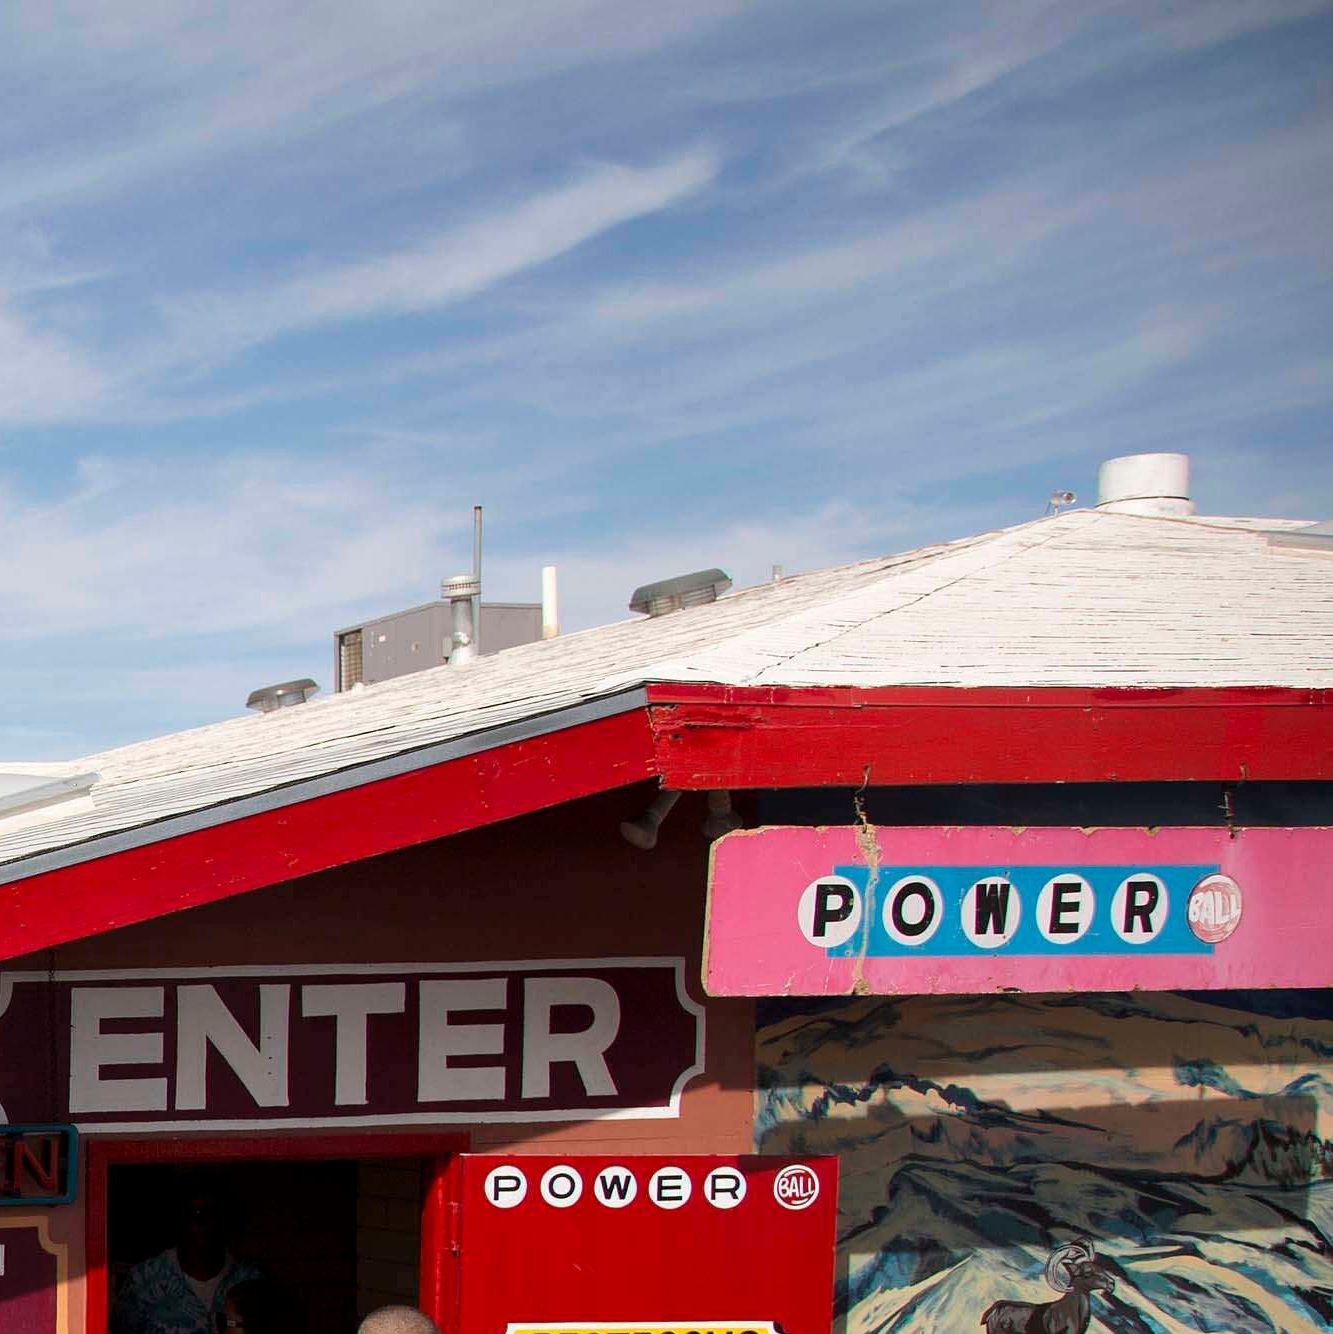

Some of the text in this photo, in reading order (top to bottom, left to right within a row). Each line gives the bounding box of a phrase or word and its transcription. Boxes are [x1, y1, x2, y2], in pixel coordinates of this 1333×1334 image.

[813, 880, 1241, 938] POWER BALL
[69, 977, 622, 1113] ENTER
[493, 1173, 816, 1202] POWER BALL
